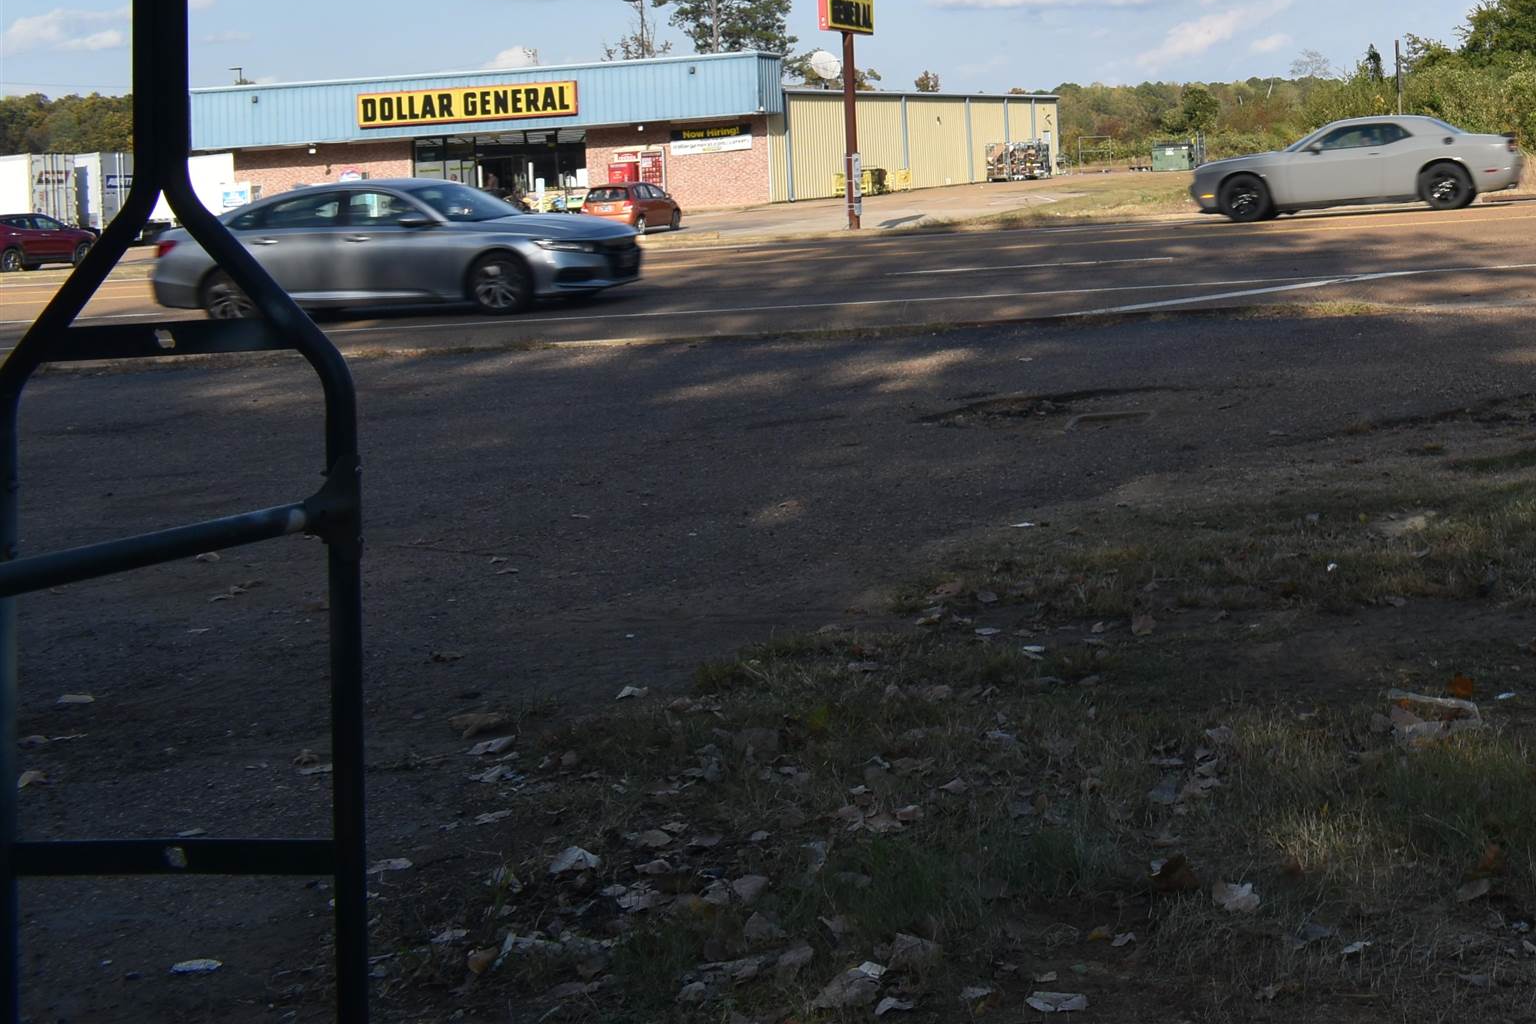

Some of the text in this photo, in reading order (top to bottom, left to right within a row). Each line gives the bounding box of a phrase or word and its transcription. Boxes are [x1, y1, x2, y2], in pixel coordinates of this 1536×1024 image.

[361, 85, 570, 122] DOLLAR GENERAL
[682, 130, 705, 139] Now
[706, 126, 740, 137] Hiring!
